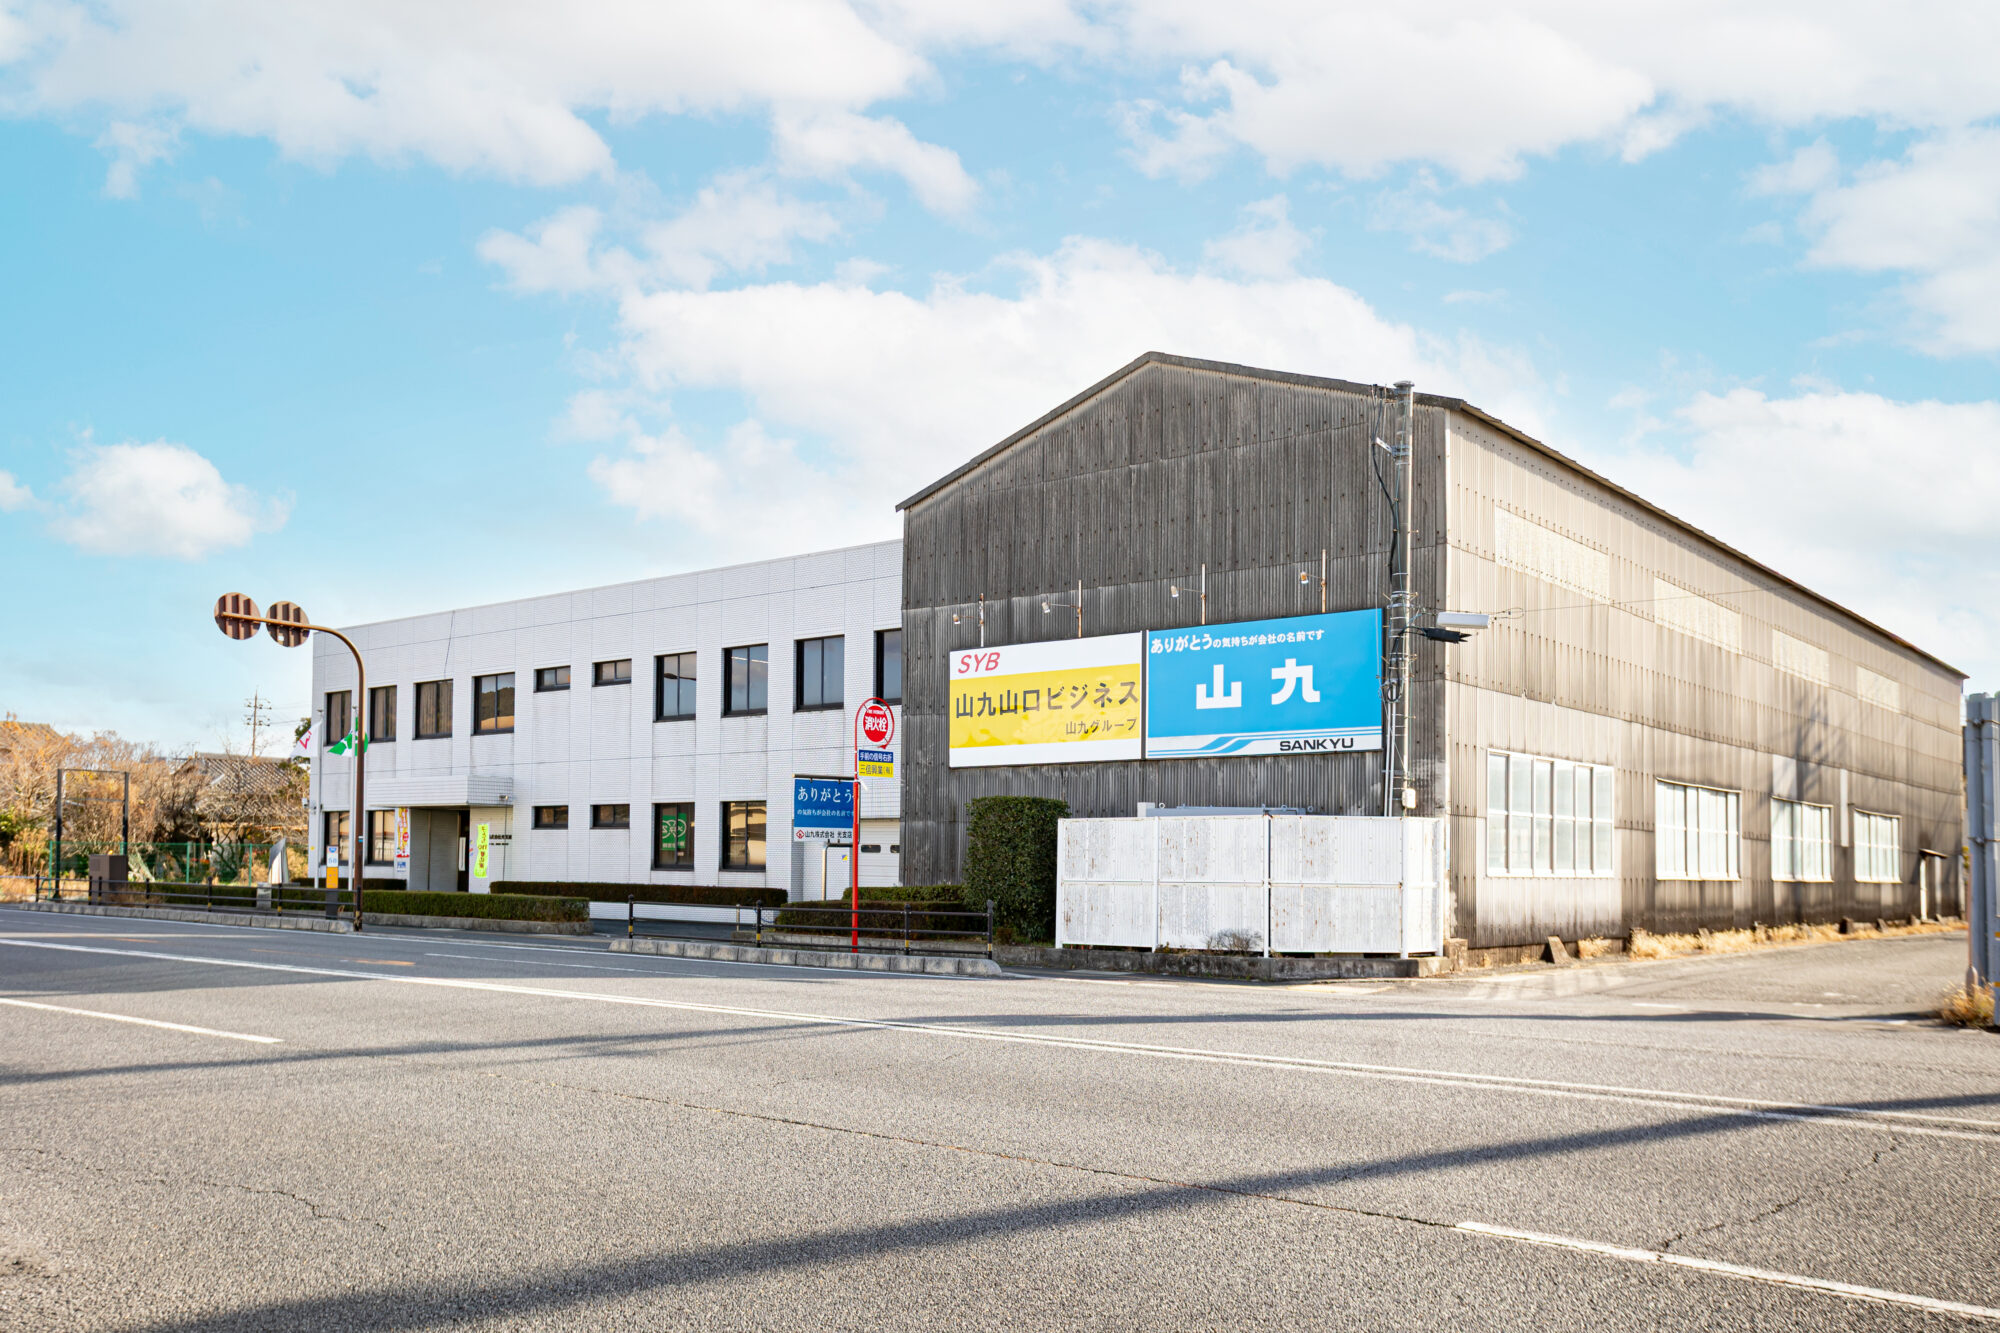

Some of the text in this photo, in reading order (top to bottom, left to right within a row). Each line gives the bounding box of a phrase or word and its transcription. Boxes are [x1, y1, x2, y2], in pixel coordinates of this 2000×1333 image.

[1150, 629, 1325, 654] ありがとうの気持ちが会社の名前です
[957, 652, 1001, 674] SYB
[1196, 658, 1321, 710] 山九
[955, 681, 1139, 719] 山九山口ビジネス
[865, 716, 888, 732] 消火栓
[1065, 717, 1137, 735] 山九グループ
[1279, 737, 1354, 751] SANKYU
